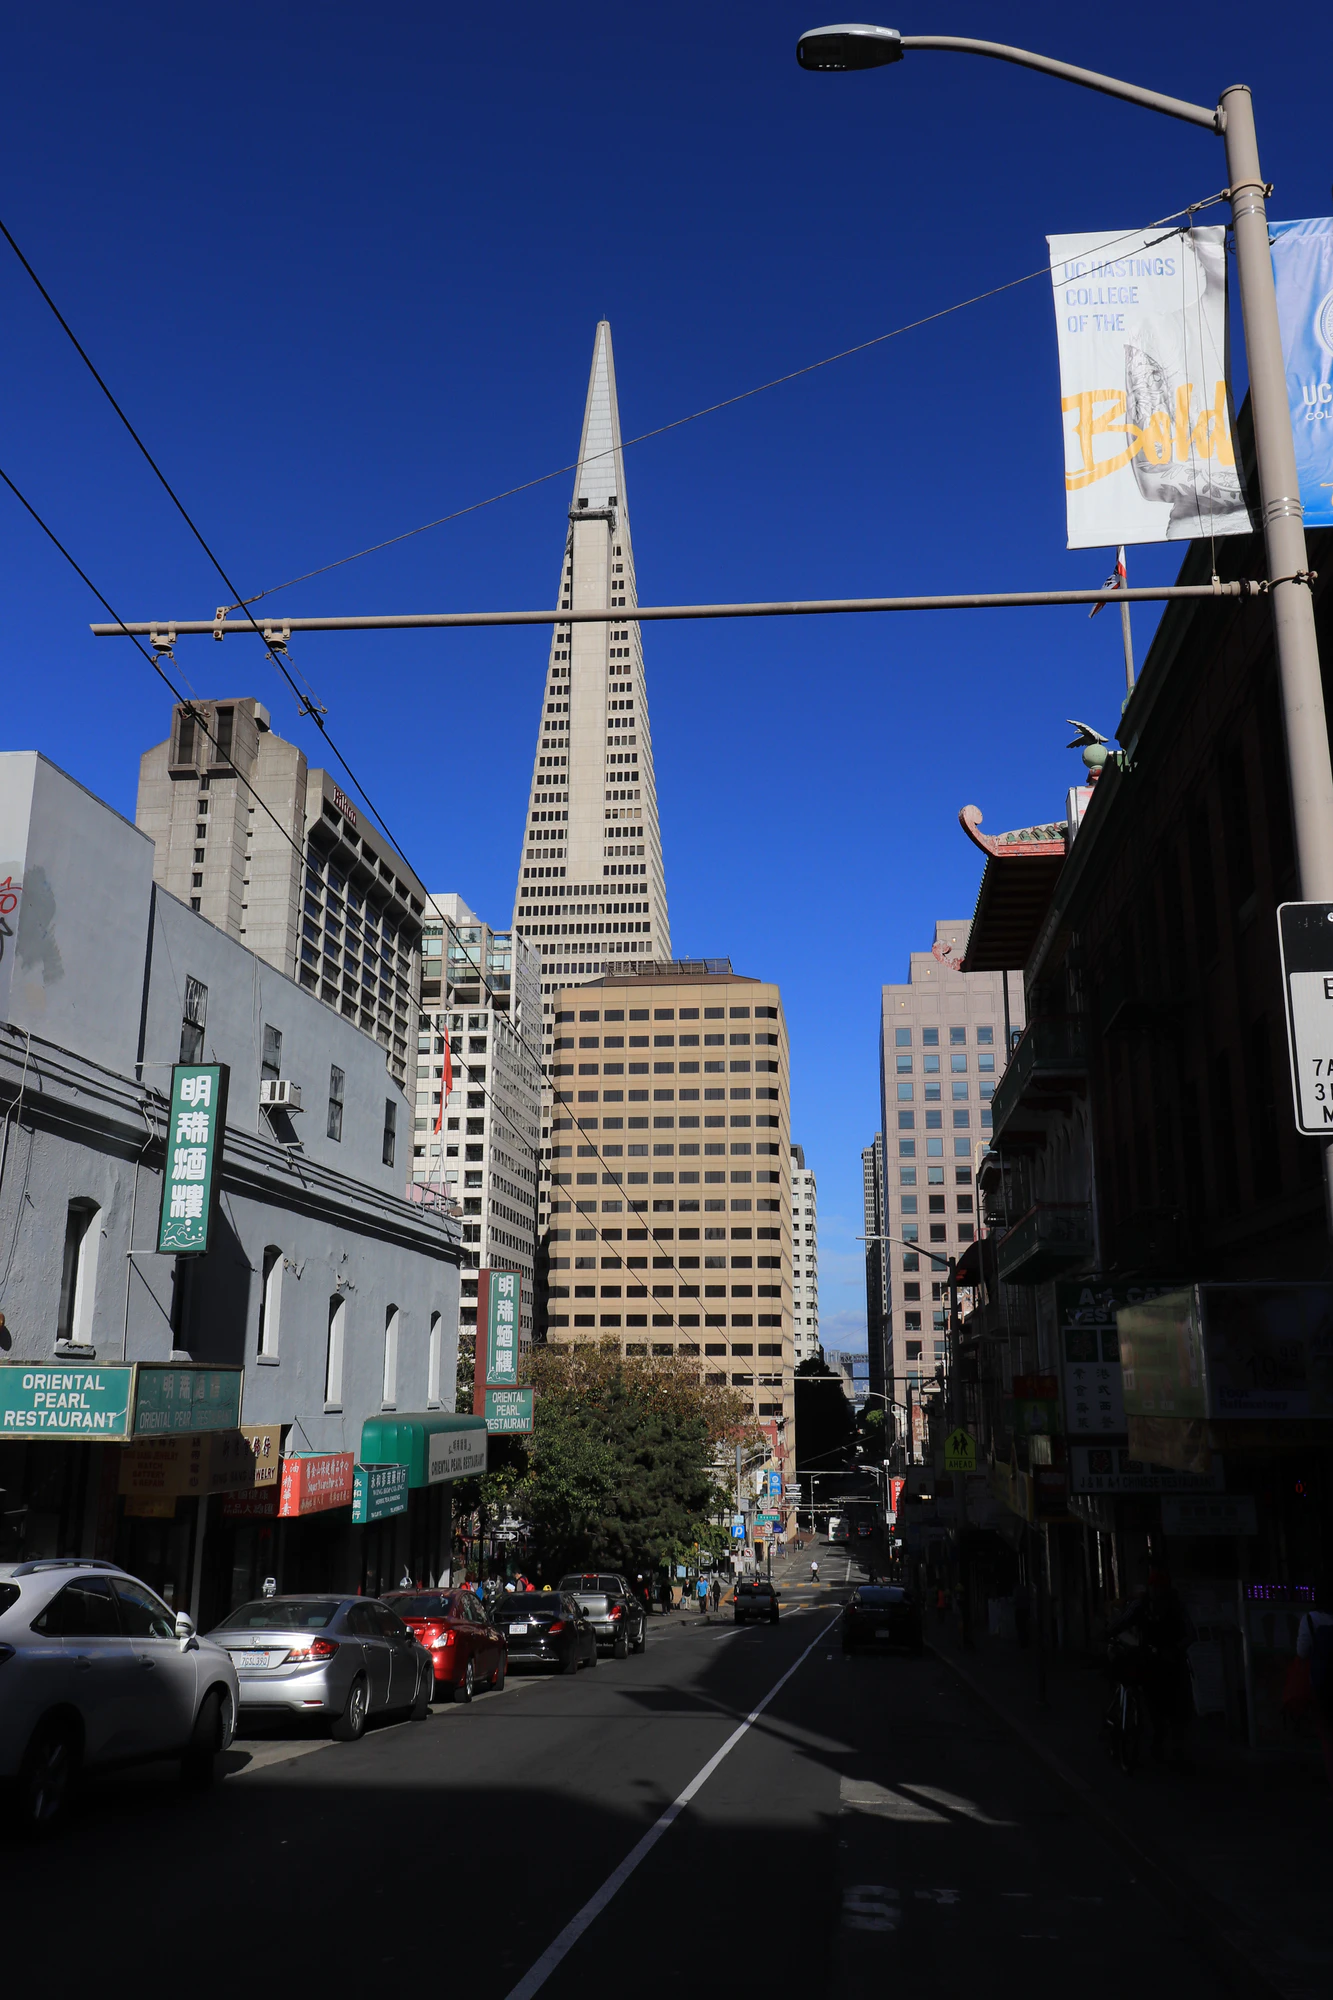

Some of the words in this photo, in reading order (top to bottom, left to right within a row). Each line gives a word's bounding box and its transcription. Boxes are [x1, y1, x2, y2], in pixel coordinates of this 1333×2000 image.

[1064, 261, 1087, 279] UC
[1091, 258, 1176, 278] HASTINGS
[1066, 286, 1139, 306] COLLEGE
[1067, 315, 1088, 333] OF
[1093, 313, 1125, 331] THE
[1303, 383, 1333, 406] UC
[1061, 381, 1235, 491] Bold
[22, 1374, 105, 1390] ORIENTAL
[34, 1392, 90, 1409] PEARL
[492, 1392, 525, 1403] ORIENTAL
[496, 1405, 520, 1416] PEARL
[4, 1410, 117, 1429] RESTAURANT
[140, 1411, 171, 1429] ORIENTAL
[485, 1417, 530, 1430] RESTAURANT
[138, 1462, 163, 1470] WATCH
[949, 1460, 973, 1469] AHEAD
[132, 1470, 165, 1479] BATTERY
[139, 1479, 164, 1488] REPAIR
[1123, 1477, 1159, 1488] CHINESE
[1162, 1477, 1216, 1489] RESTAURANT
